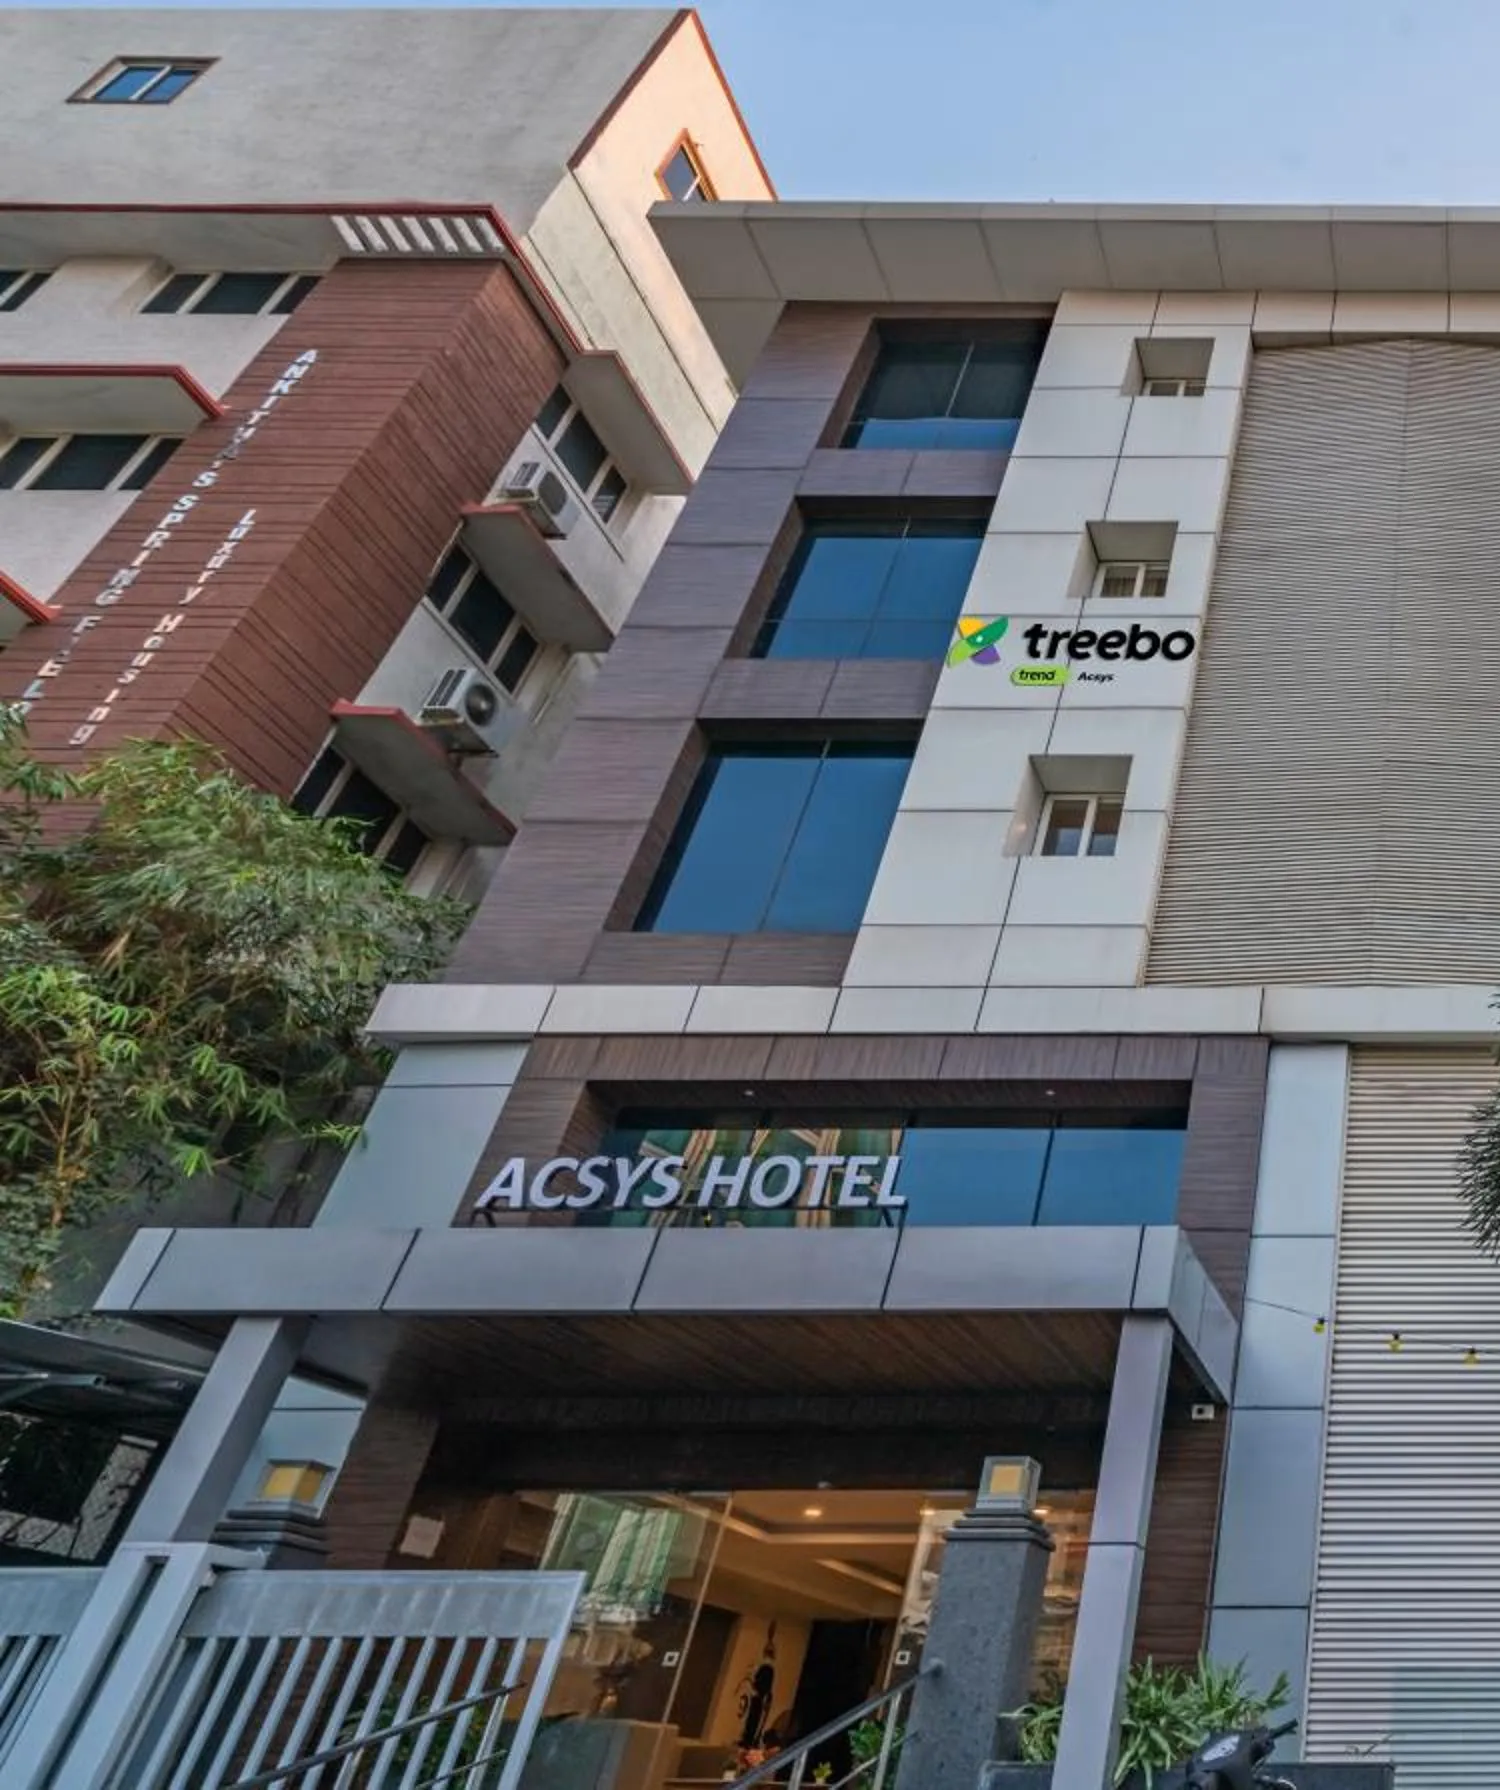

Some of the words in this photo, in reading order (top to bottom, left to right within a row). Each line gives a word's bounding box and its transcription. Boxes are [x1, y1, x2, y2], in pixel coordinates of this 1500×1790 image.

[95, 495, 199, 607] SPRING
[178, 509, 257, 605] Luxury
[68, 613, 184, 745] Housing
[1019, 669, 1057, 682] trend
[1077, 671, 1114, 683] Acsys
[1023, 623, 1196, 661] treebo
[474, 1156, 687, 1209] ACSYS
[696, 1155, 907, 1208] HOTEL
